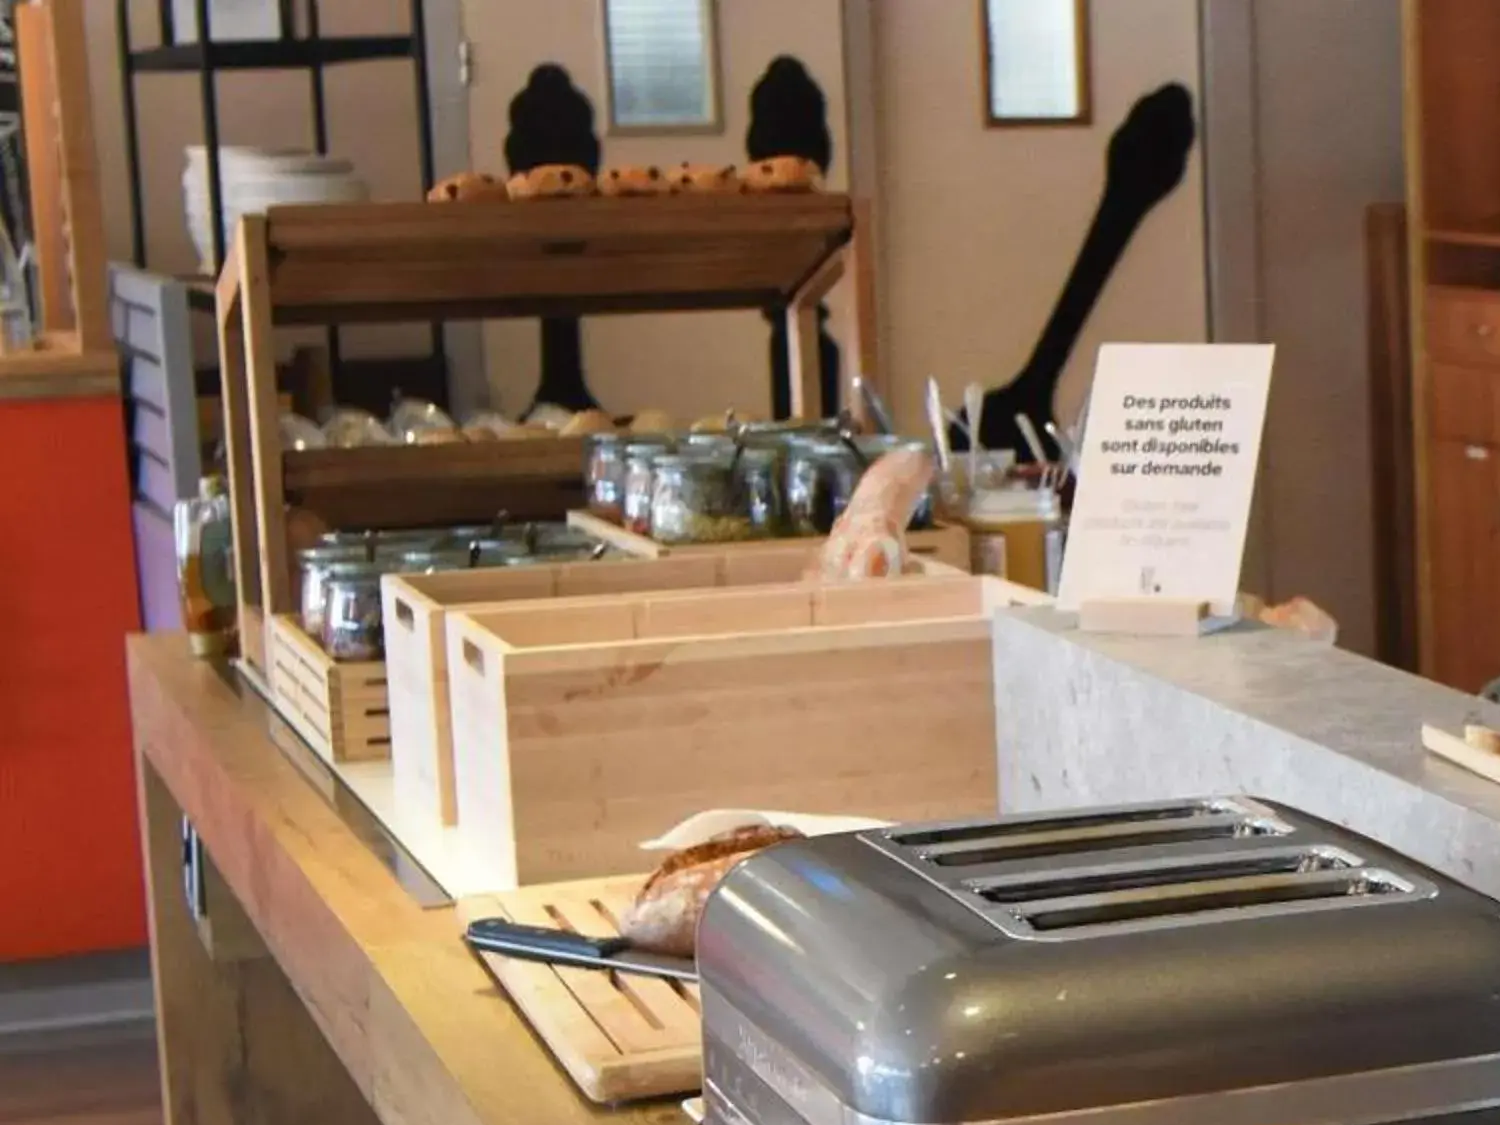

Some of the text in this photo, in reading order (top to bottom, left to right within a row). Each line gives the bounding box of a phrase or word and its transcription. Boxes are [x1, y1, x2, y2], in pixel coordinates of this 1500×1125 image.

[1122, 394, 1232, 413] Des produits
[1124, 417, 1224, 434] sans gluten
[1100, 437, 1240, 457] sont disponibles
[1110, 460, 1223, 476] sur demande
